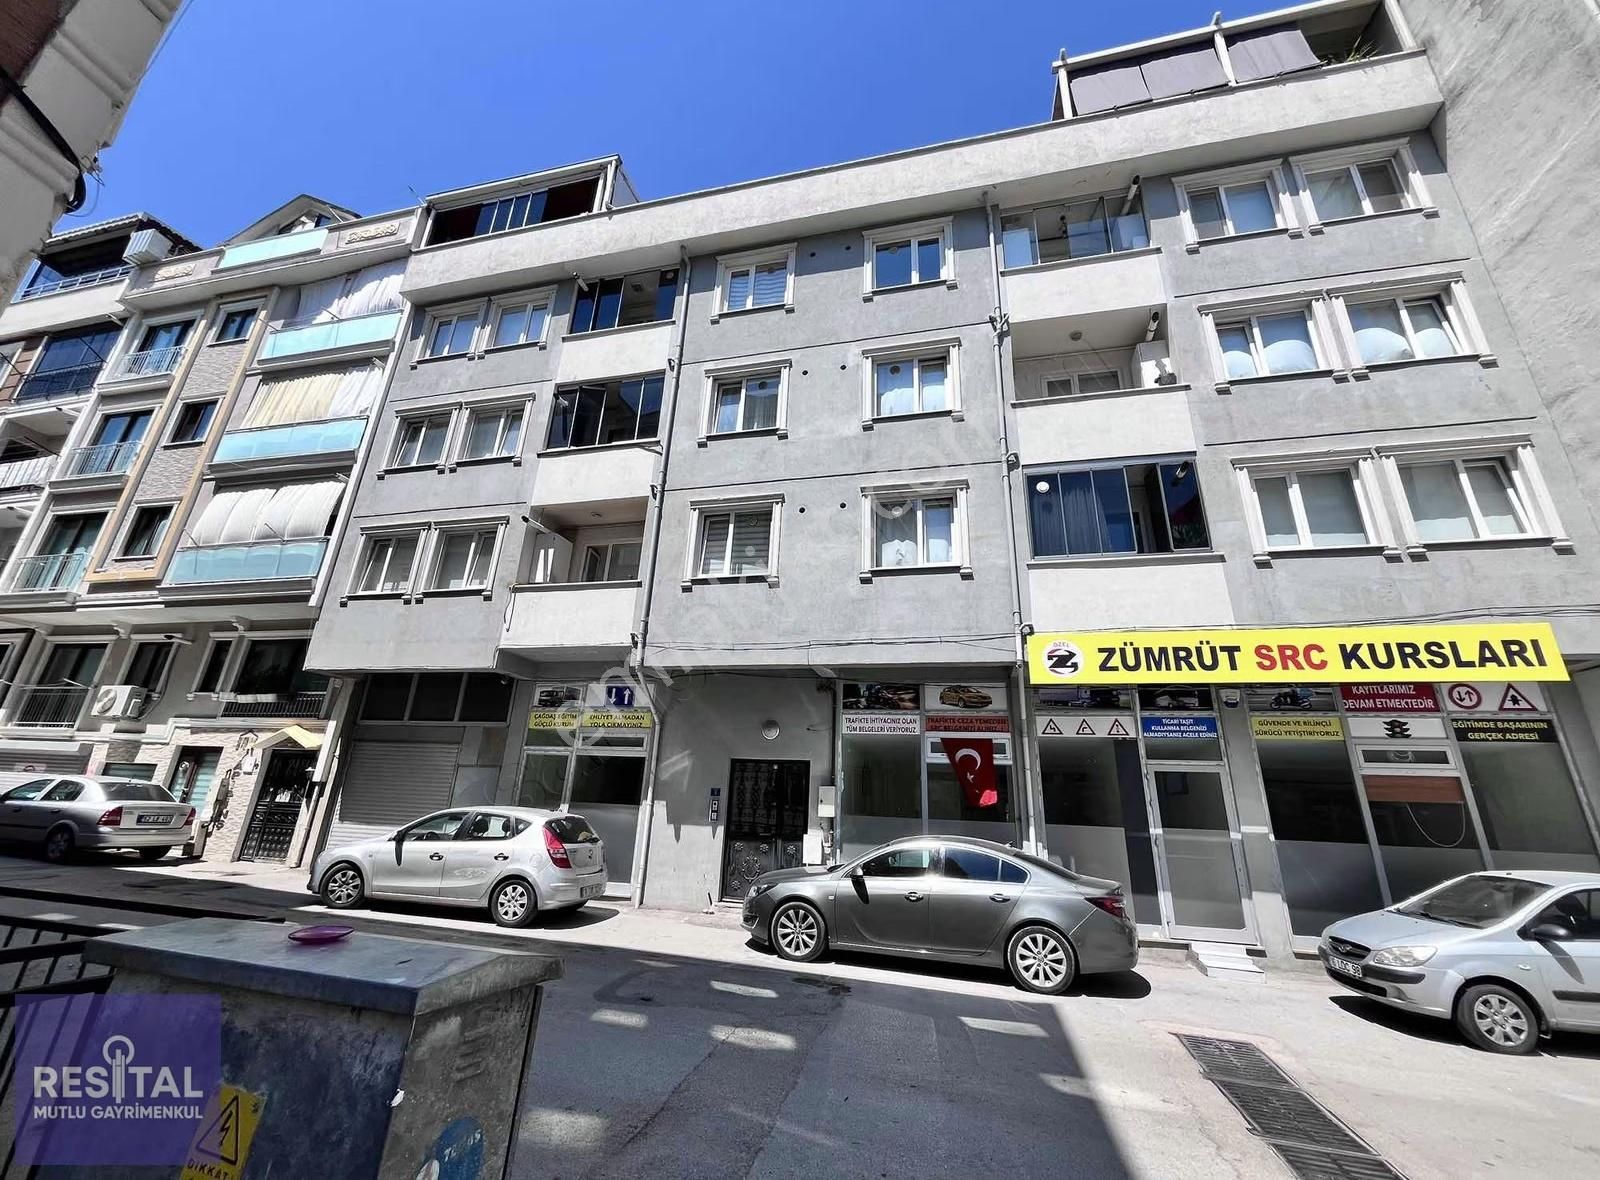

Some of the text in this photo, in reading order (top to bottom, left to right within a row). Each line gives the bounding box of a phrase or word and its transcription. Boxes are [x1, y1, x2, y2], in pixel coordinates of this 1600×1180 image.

[1097, 638, 1548, 672] ZÜMRÜT SRC KURSLARI
[1351, 684, 1416, 695] KAYITLARIMIZ
[1343, 696, 1435, 709] DEVAM ETMEKTEDİR
[901, 717, 917, 725] OLAN
[1258, 718, 1291, 727] GÜVENDE
[1292, 719, 1302, 727] VE
[1497, 720, 1548, 730] BAŞARININ
[846, 724, 857, 733] TÜM
[858, 724, 885, 733] BELGELERİ
[1254, 728, 1282, 737] SÜRÜCÜ
[1467, 731, 1539, 741] GERÇEK ADRESİ
